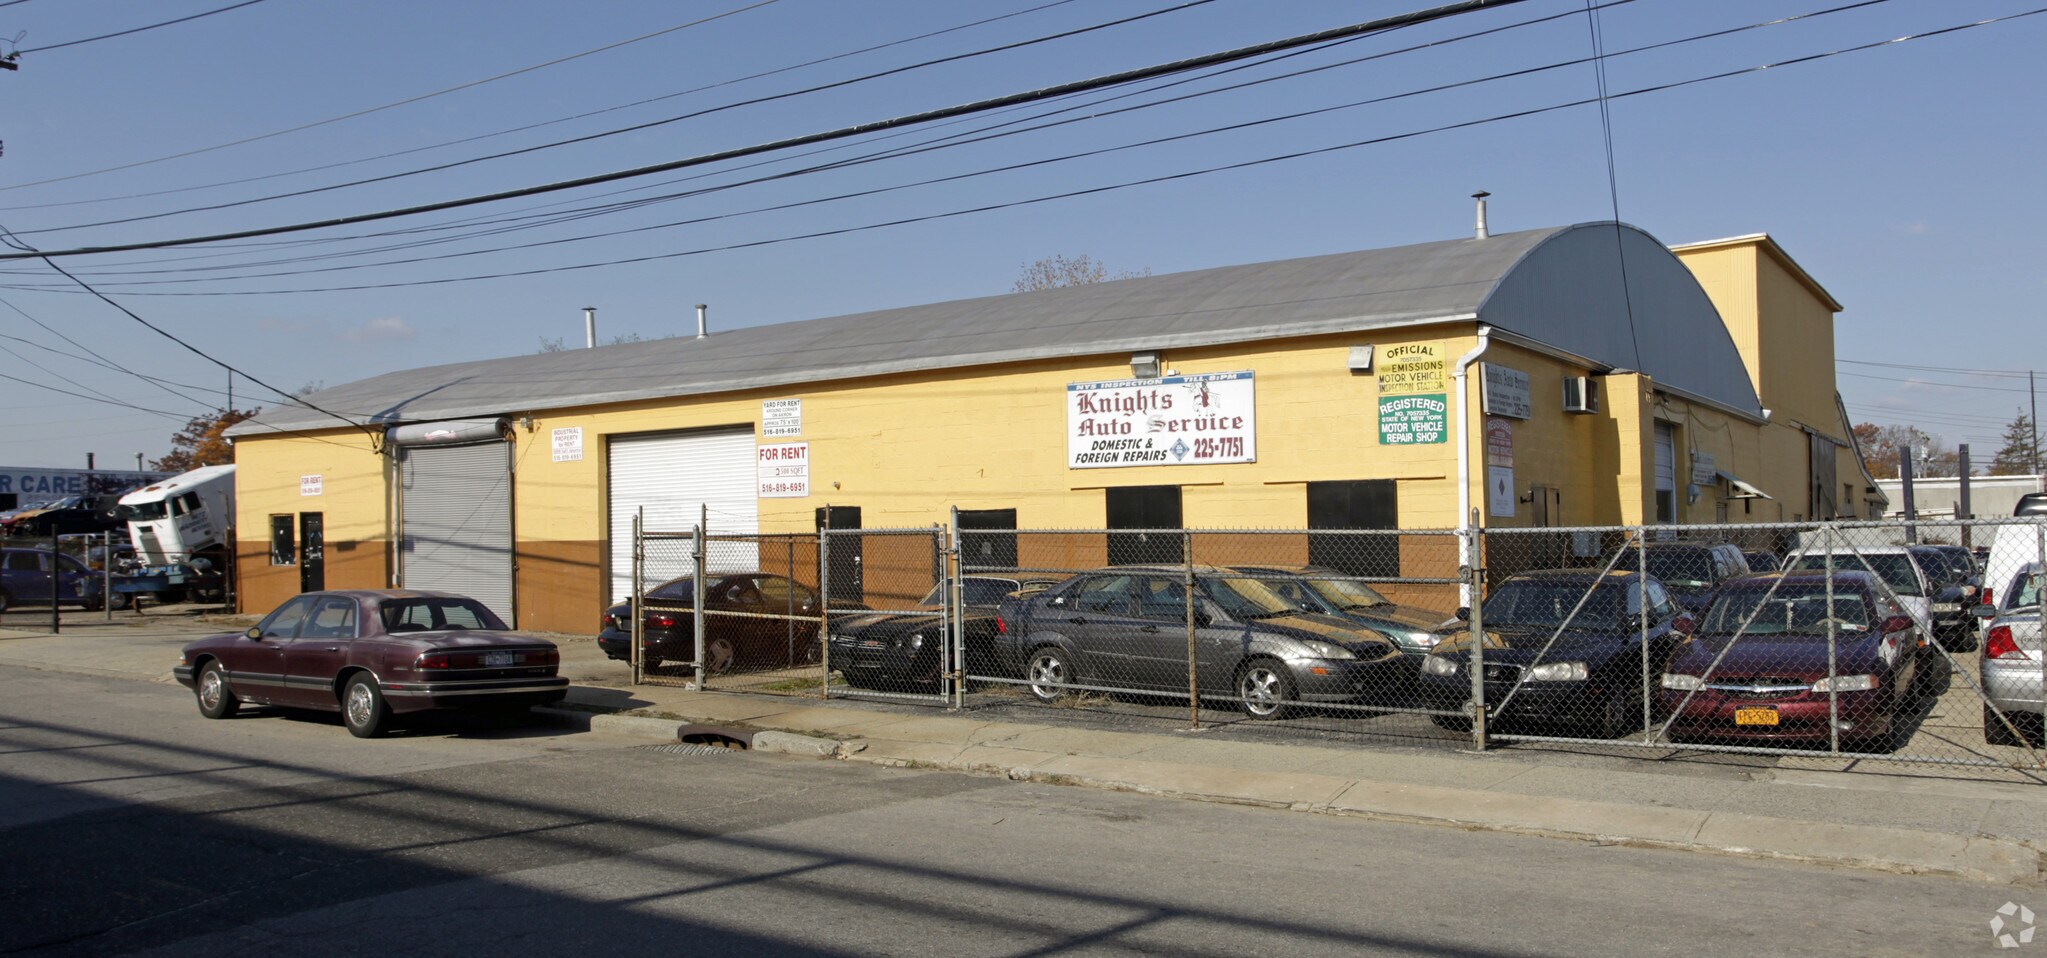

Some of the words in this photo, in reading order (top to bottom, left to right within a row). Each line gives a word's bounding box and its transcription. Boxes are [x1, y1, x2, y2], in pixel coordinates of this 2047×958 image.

[1387, 346, 1434, 358] OFFICIAL
[1392, 361, 1443, 372] EMISSIONS
[1380, 374, 1406, 382] MOTOR
[1410, 372, 1442, 380] VEHICLE
[1100, 379, 1163, 388] INSPECTION
[1380, 384, 1414, 392] INSPECTION
[1076, 389, 1172, 416] Knights
[1380, 398, 1444, 416] REGISTERED
[1078, 418, 1132, 437] Auto
[1147, 414, 1244, 434] Service
[1382, 423, 1408, 432] MOTOR
[1411, 422, 1442, 431] VEHICLE
[1387, 433, 1413, 443] REPAIR
[1416, 432, 1438, 442] SHOP
[1092, 438, 1142, 451] DOMESTIC
[1146, 438, 1153, 448] &
[1194, 436, 1244, 458] 225-7751
[760, 448, 778, 460] FOR
[782, 446, 806, 459] RENT
[1076, 452, 1120, 464] FOREIGN
[1123, 450, 1167, 462] REPAIRS
[20, 476, 80, 493] CARE
[762, 483, 805, 492] 516-819-6951
